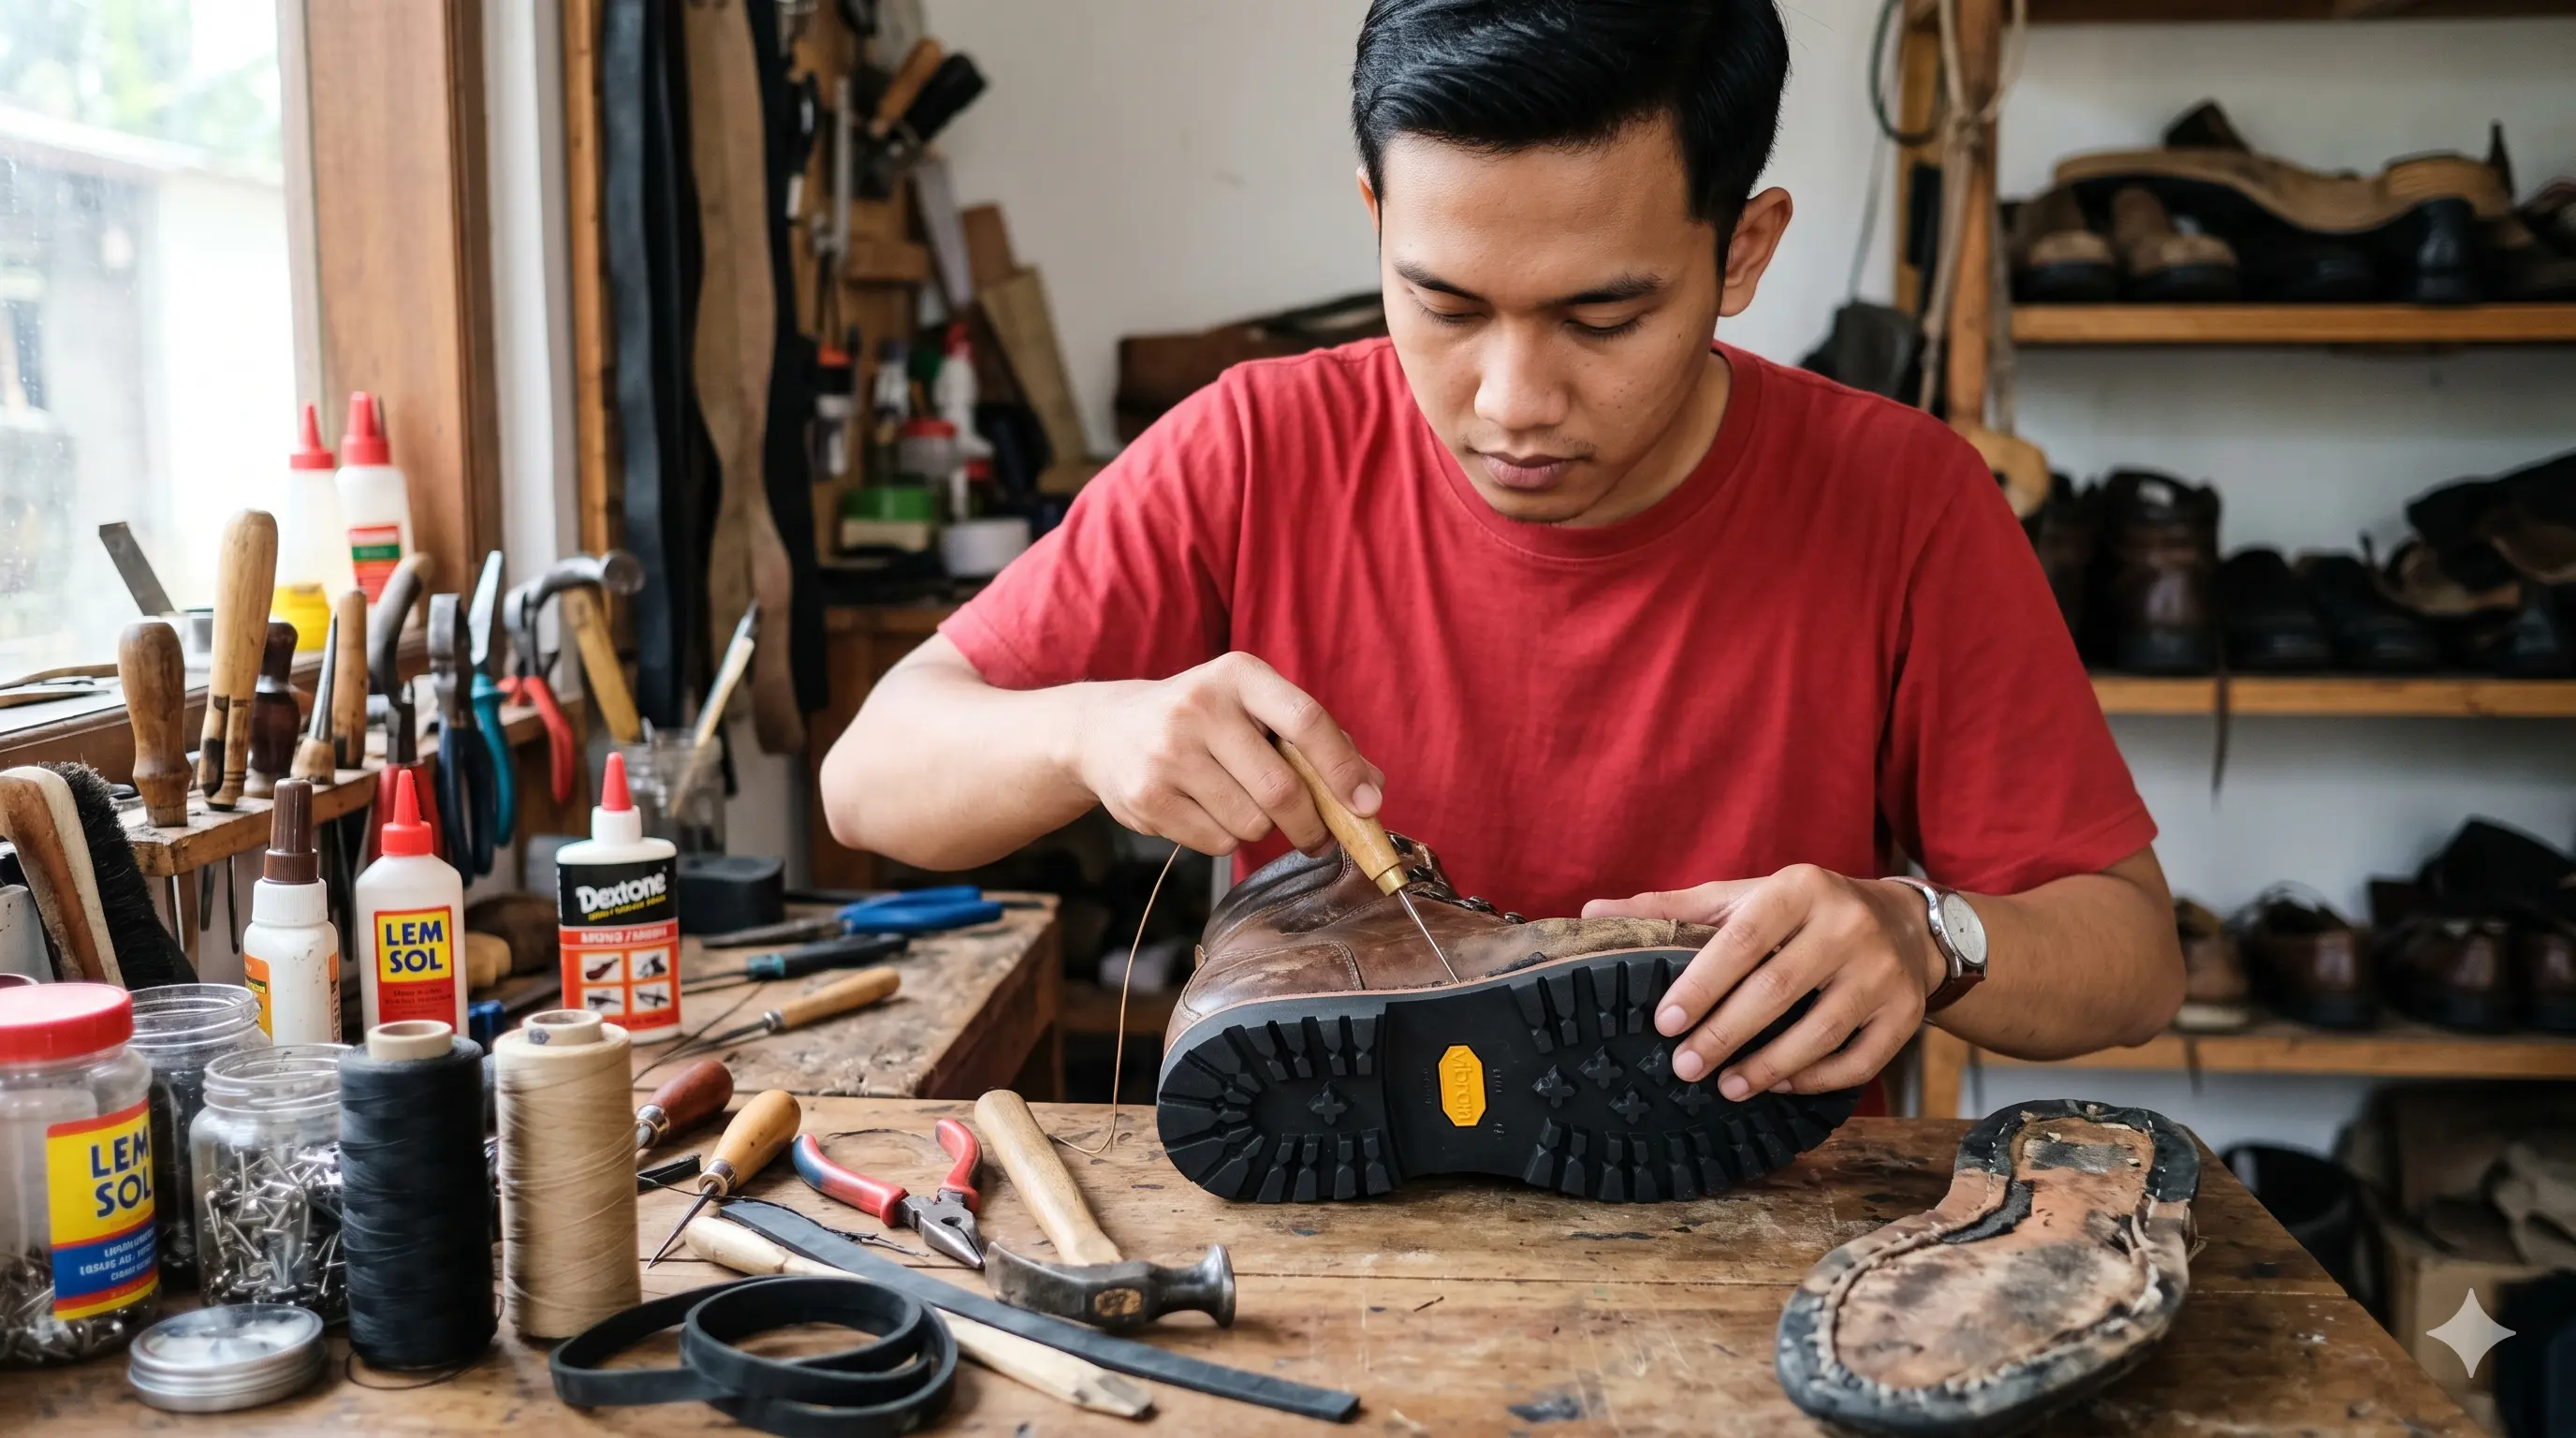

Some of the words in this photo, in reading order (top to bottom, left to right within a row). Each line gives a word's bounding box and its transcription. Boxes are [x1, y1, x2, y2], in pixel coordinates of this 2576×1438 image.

[576, 873, 666, 915] Dextone
[386, 920, 443, 946] LEM
[389, 947, 443, 973] SOL
[91, 1125, 150, 1179] LEM
[95, 1166, 152, 1218] SOL
